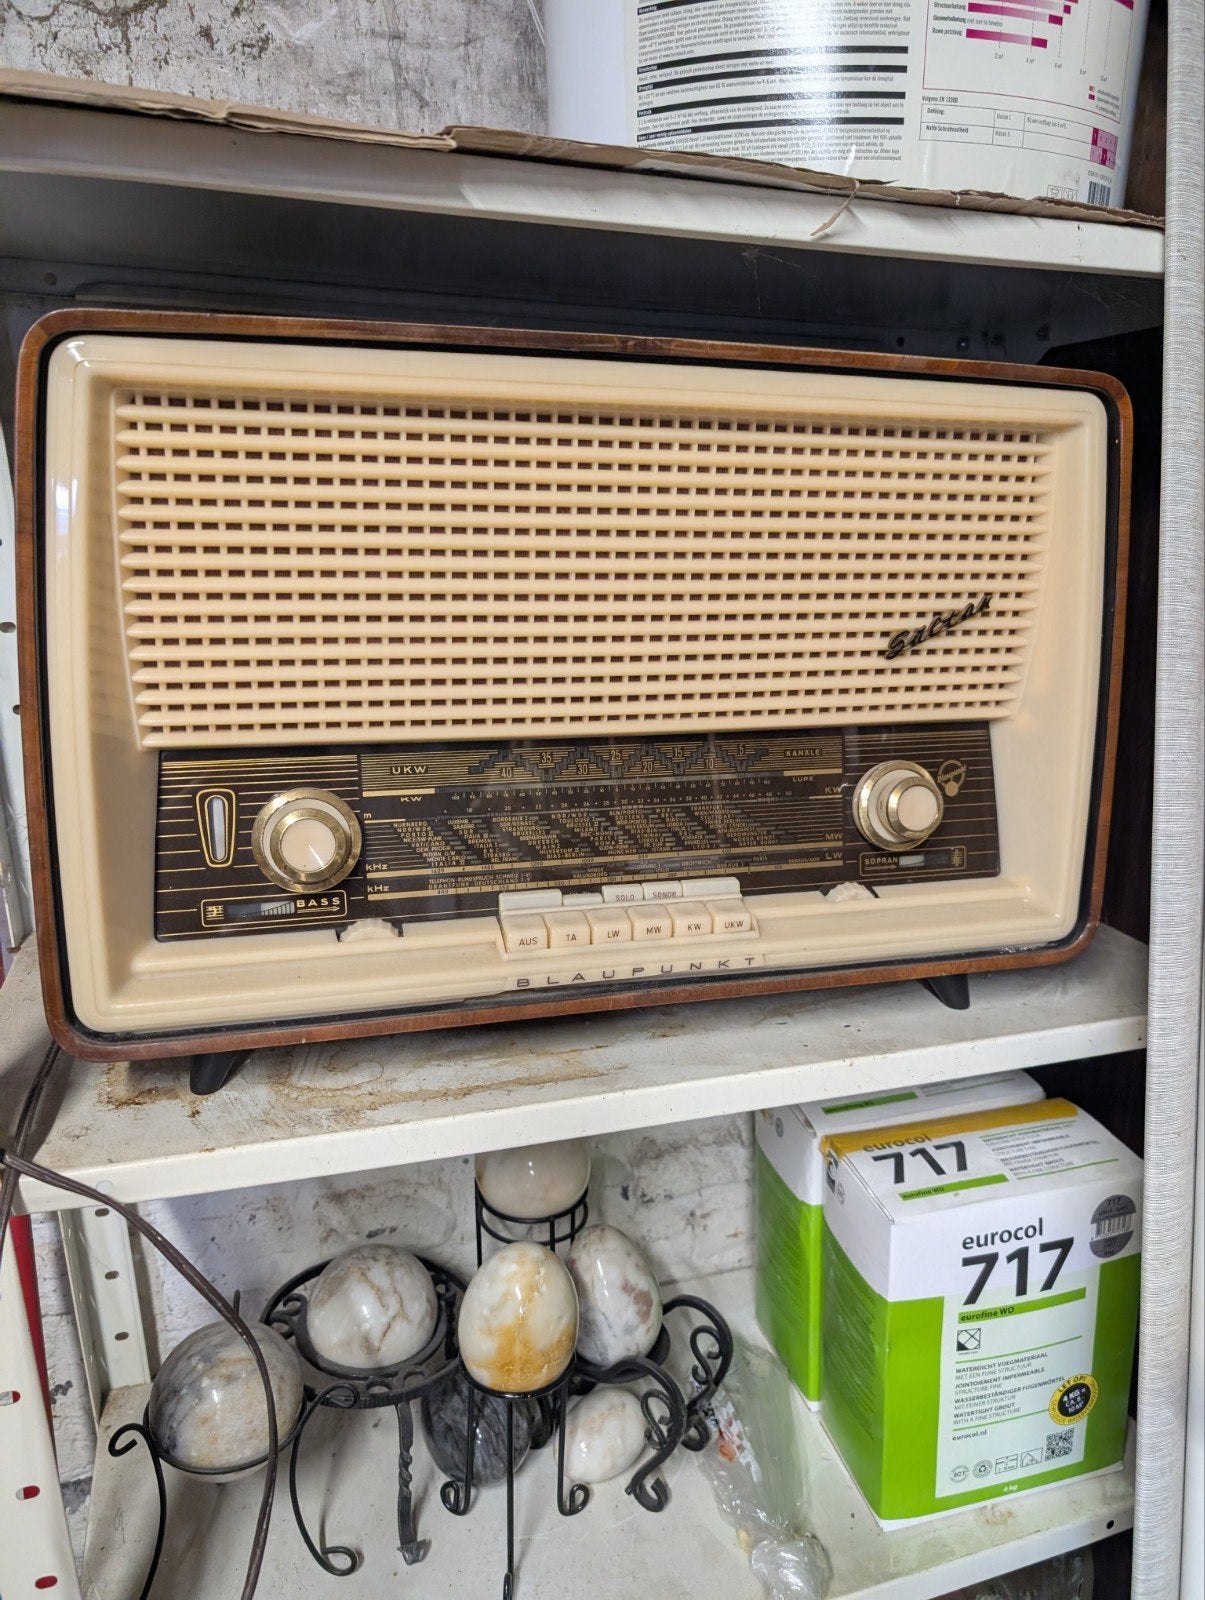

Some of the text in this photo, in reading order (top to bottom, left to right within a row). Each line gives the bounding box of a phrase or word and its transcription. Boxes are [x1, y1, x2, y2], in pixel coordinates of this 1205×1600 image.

[611, 750, 621, 760] 25
[674, 746, 682, 757] 15
[739, 744, 746, 755] 5
[541, 752, 552, 763] 35
[642, 761, 653, 772] 20
[704, 758, 714, 769] 10
[392, 765, 427, 775] UKW
[501, 768, 512, 779] 40
[578, 764, 588, 775] 30
[825, 833, 843, 841] MW
[825, 852, 842, 860] LW
[864, 857, 898, 866] SOPRAN
[367, 884, 390, 893] kHz
[615, 894, 635, 902] SOLO
[653, 891, 677, 899] SONOR
[296, 897, 340, 908] BASS
[646, 926, 662, 935] MW
[687, 923, 702, 931] KW
[724, 920, 745, 930] UKW
[565, 934, 578, 942] TA
[608, 930, 620, 939] LW
[519, 937, 538, 948] AUS
[516, 958, 756, 988] BLAUPUNKT
[863, 1134, 933, 1152] eurocol
[871, 1141, 969, 1185] 717
[902, 1189, 931, 1200] eurofine
[962, 1216, 1043, 1250] eurocol
[962, 1236, 1074, 1306] 717
[960, 1306, 1015, 1322] eurofine WD
[955, 1353, 1048, 1374] WATERDICHT VOEGMATERIAAL
[955, 1373, 967, 1382] MET
[998, 1362, 1032, 1374] STRUCTUUR
[955, 1367, 1045, 1390] JOINTOIEMENT IMPERMEABLE
[954, 1382, 1002, 1396] STRUCTURE FINE
[954, 1376, 1065, 1404] WASSERBESTÄNDIGER FUGENMÖRTEL
[1058, 1380, 1070, 1393] LET
[1062, 1394, 1068, 1402] 4
[1068, 1390, 1080, 1398] KG
[1065, 1400, 1076, 1408] CA.
[954, 1402, 1016, 1419] WATERTIGHT GROUT
[954, 1417, 969, 1425] WITH
[974, 1412, 987, 1421] FINE
[987, 1406, 1021, 1419] STRUCTURE
[1068, 1406, 1075, 1414] 10
[952, 1429, 988, 1441] eurocol.nl
